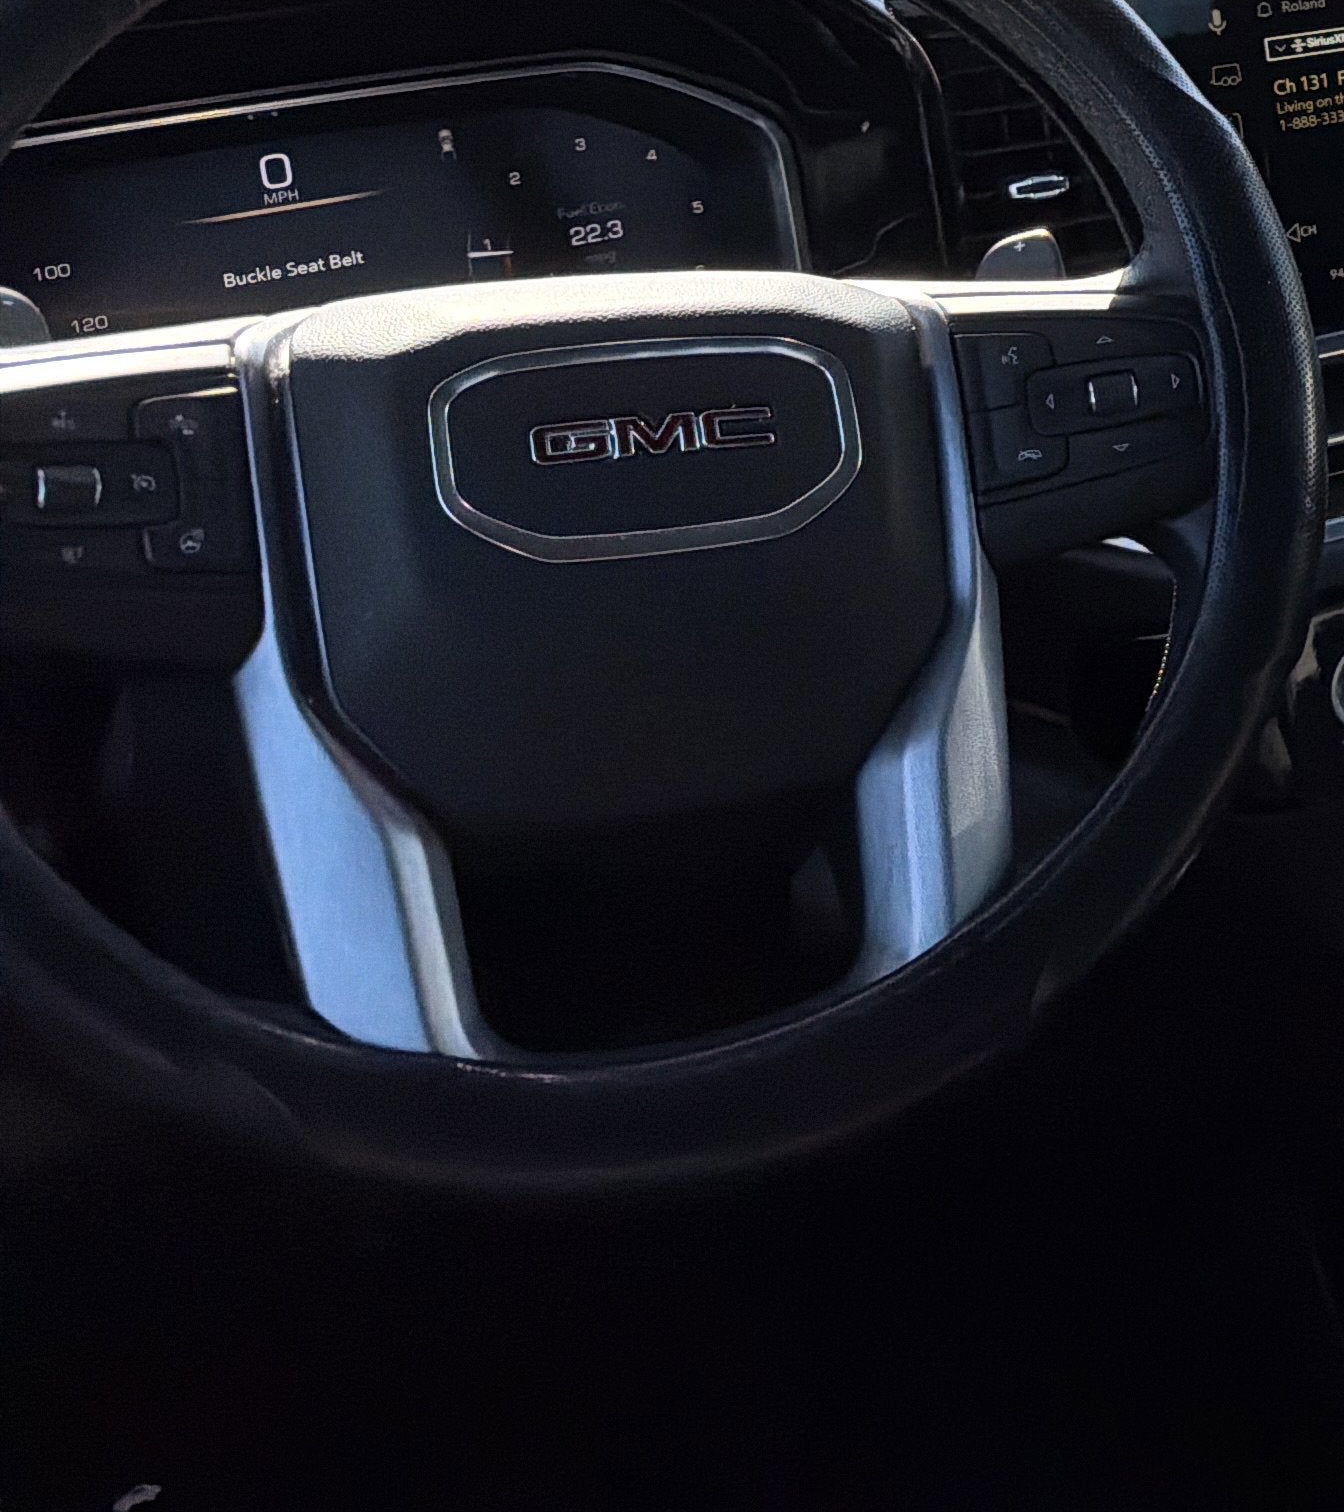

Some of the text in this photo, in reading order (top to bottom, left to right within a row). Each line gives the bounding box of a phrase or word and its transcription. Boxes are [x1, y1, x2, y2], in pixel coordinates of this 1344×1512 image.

[1273, 78, 1296, 96] Ch
[1300, 73, 1329, 92] 131
[1276, 98, 1314, 115] Living
[1316, 97, 1332, 108] on
[574, 137, 587, 151] 3
[645, 149, 658, 161] 4
[259, 153, 293, 190] 0
[509, 171, 522, 186] 2
[264, 189, 300, 205] MPH
[691, 200, 705, 214] 5
[569, 219, 624, 246] 22.3
[1300, 224, 1317, 237] CH
[33, 263, 71, 283] 100
[223, 250, 366, 289] Buckle Seat Belt
[71, 315, 109, 334] 120
[529, 406, 777, 466] GMC
